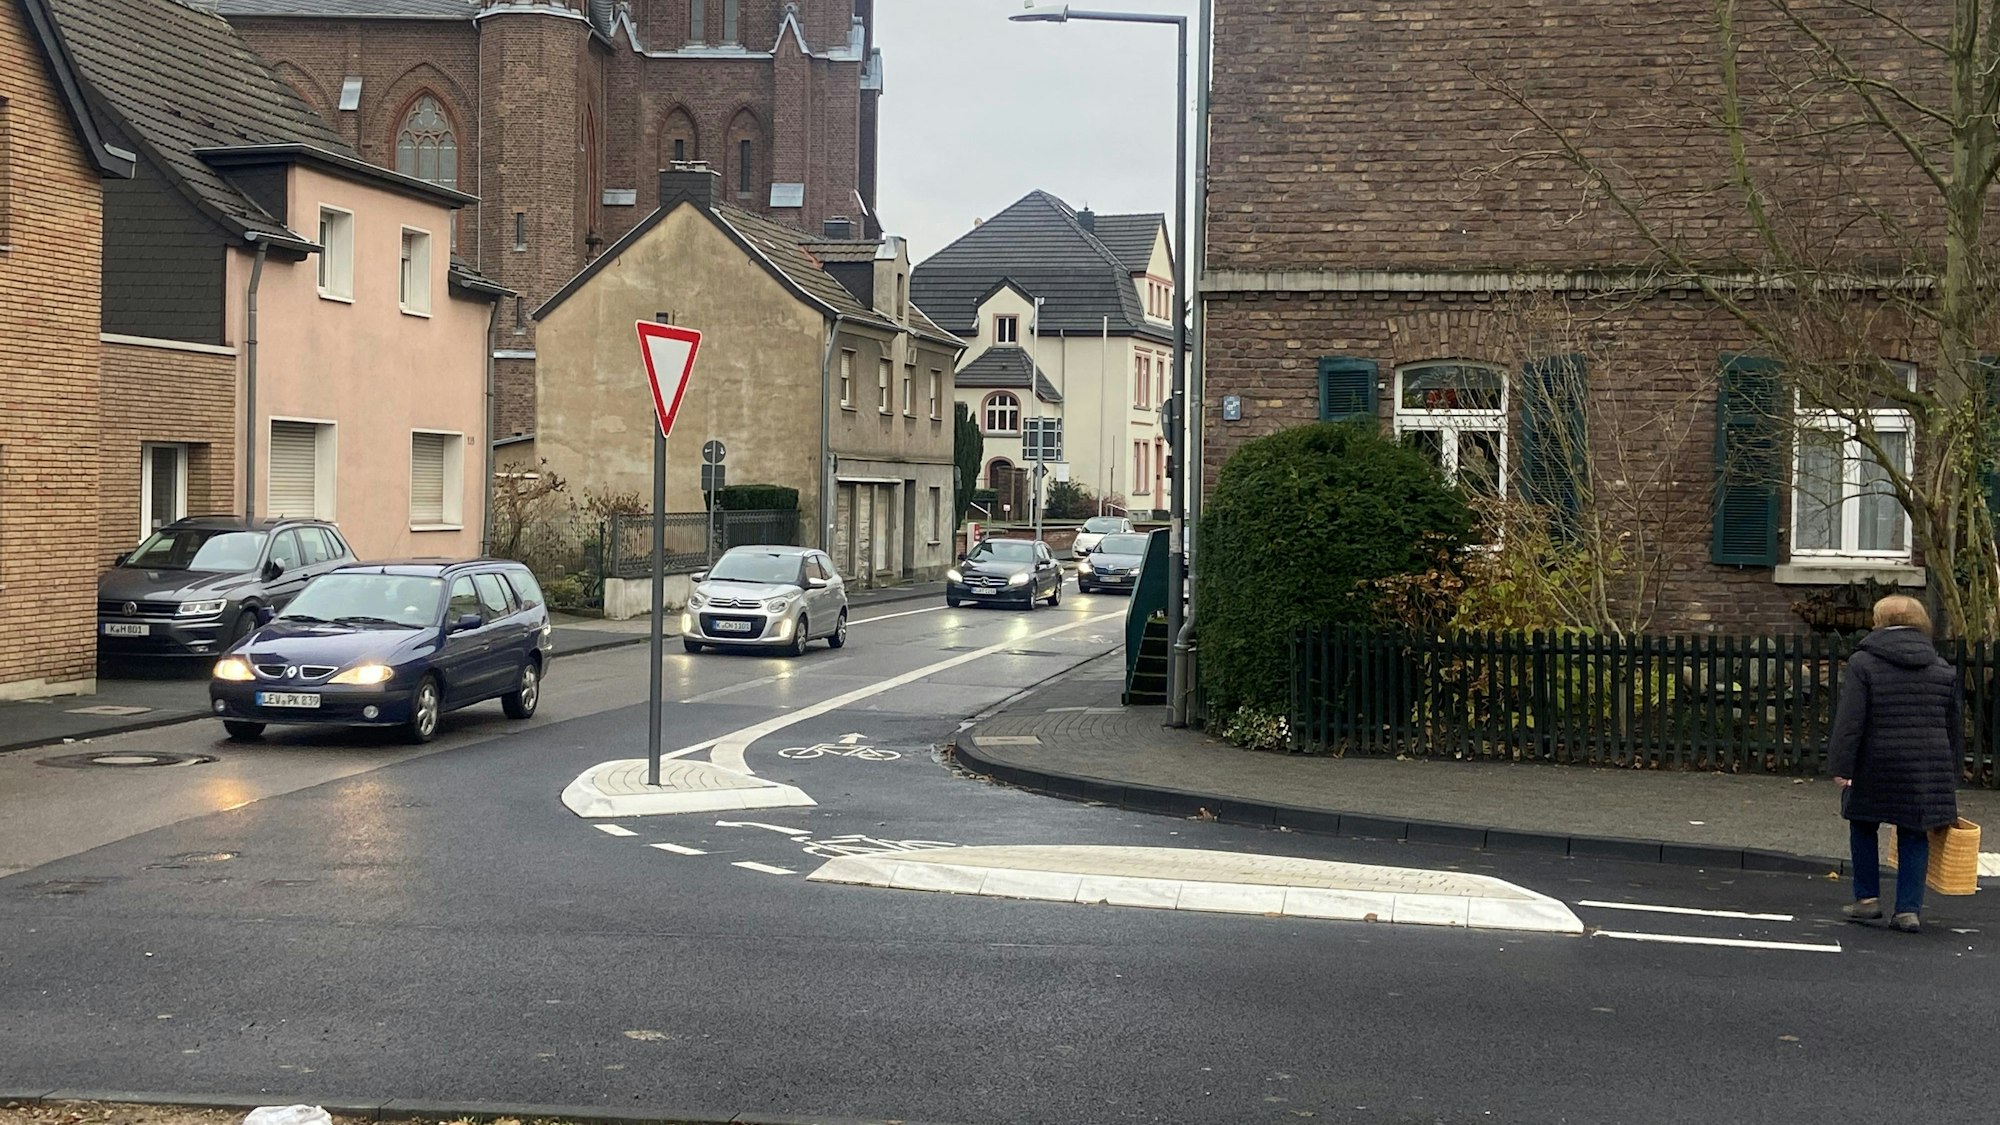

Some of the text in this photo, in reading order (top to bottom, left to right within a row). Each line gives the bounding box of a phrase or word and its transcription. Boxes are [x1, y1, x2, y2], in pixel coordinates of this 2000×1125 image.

[262, 693, 320, 706] LEV PK 839
